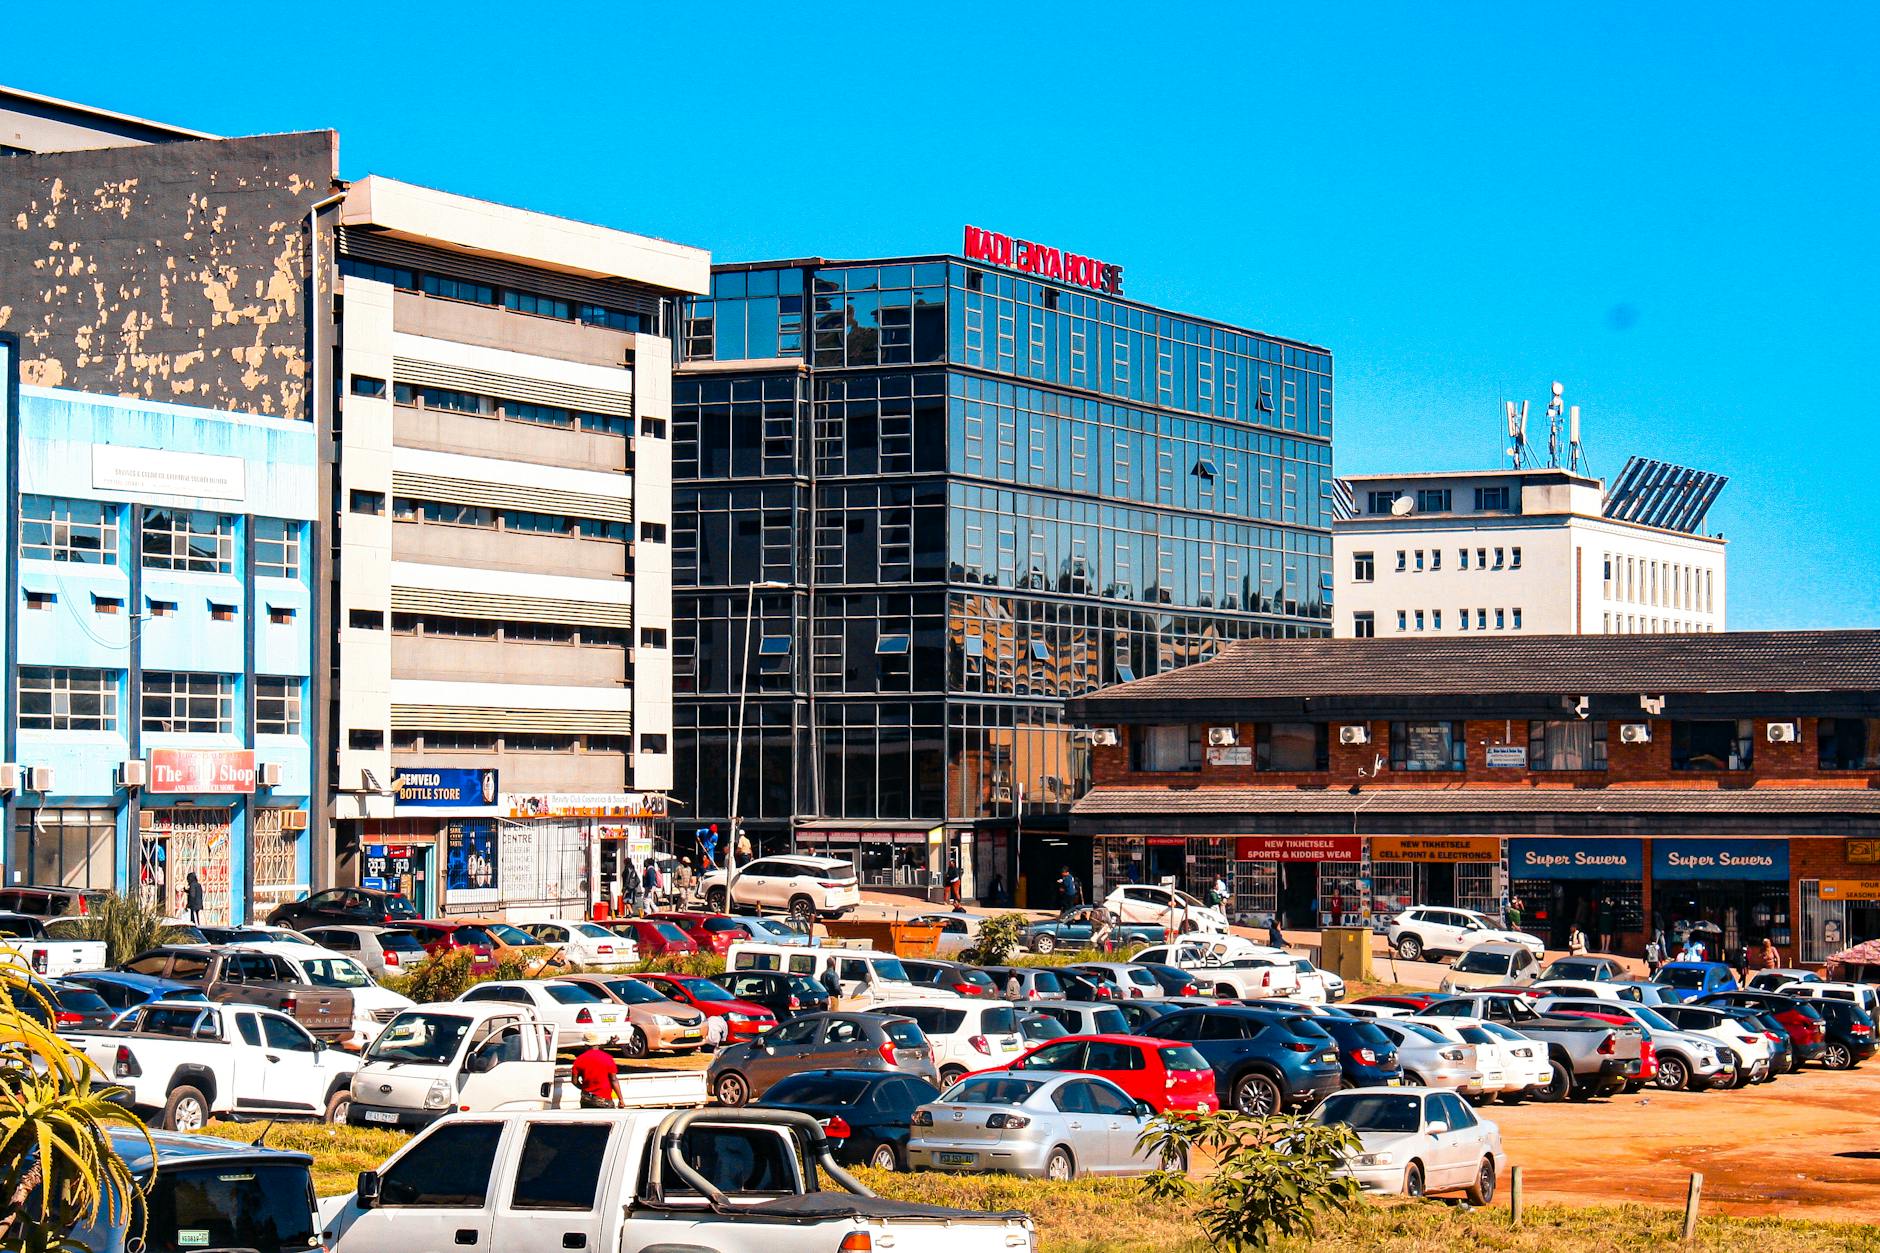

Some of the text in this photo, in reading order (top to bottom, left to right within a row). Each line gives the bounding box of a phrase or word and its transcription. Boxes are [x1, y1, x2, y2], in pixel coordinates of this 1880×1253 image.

[1064, 252, 1124, 296] HOUSE
[155, 765, 182, 783] The
[220, 765, 254, 785] Shop
[400, 788, 460, 800] BOTTLE STORE
[1265, 840, 1335, 848] NEW TIKHETSELE
[1247, 851, 1352, 859] SPORTS & KIDDIES WEAR
[1379, 851, 1400, 859] CELL
[1402, 851, 1427, 859] POINT
[1429, 851, 1436, 859] &
[1525, 851, 1627, 867] Super Savers
[1668, 852, 1773, 868] Super Savers
